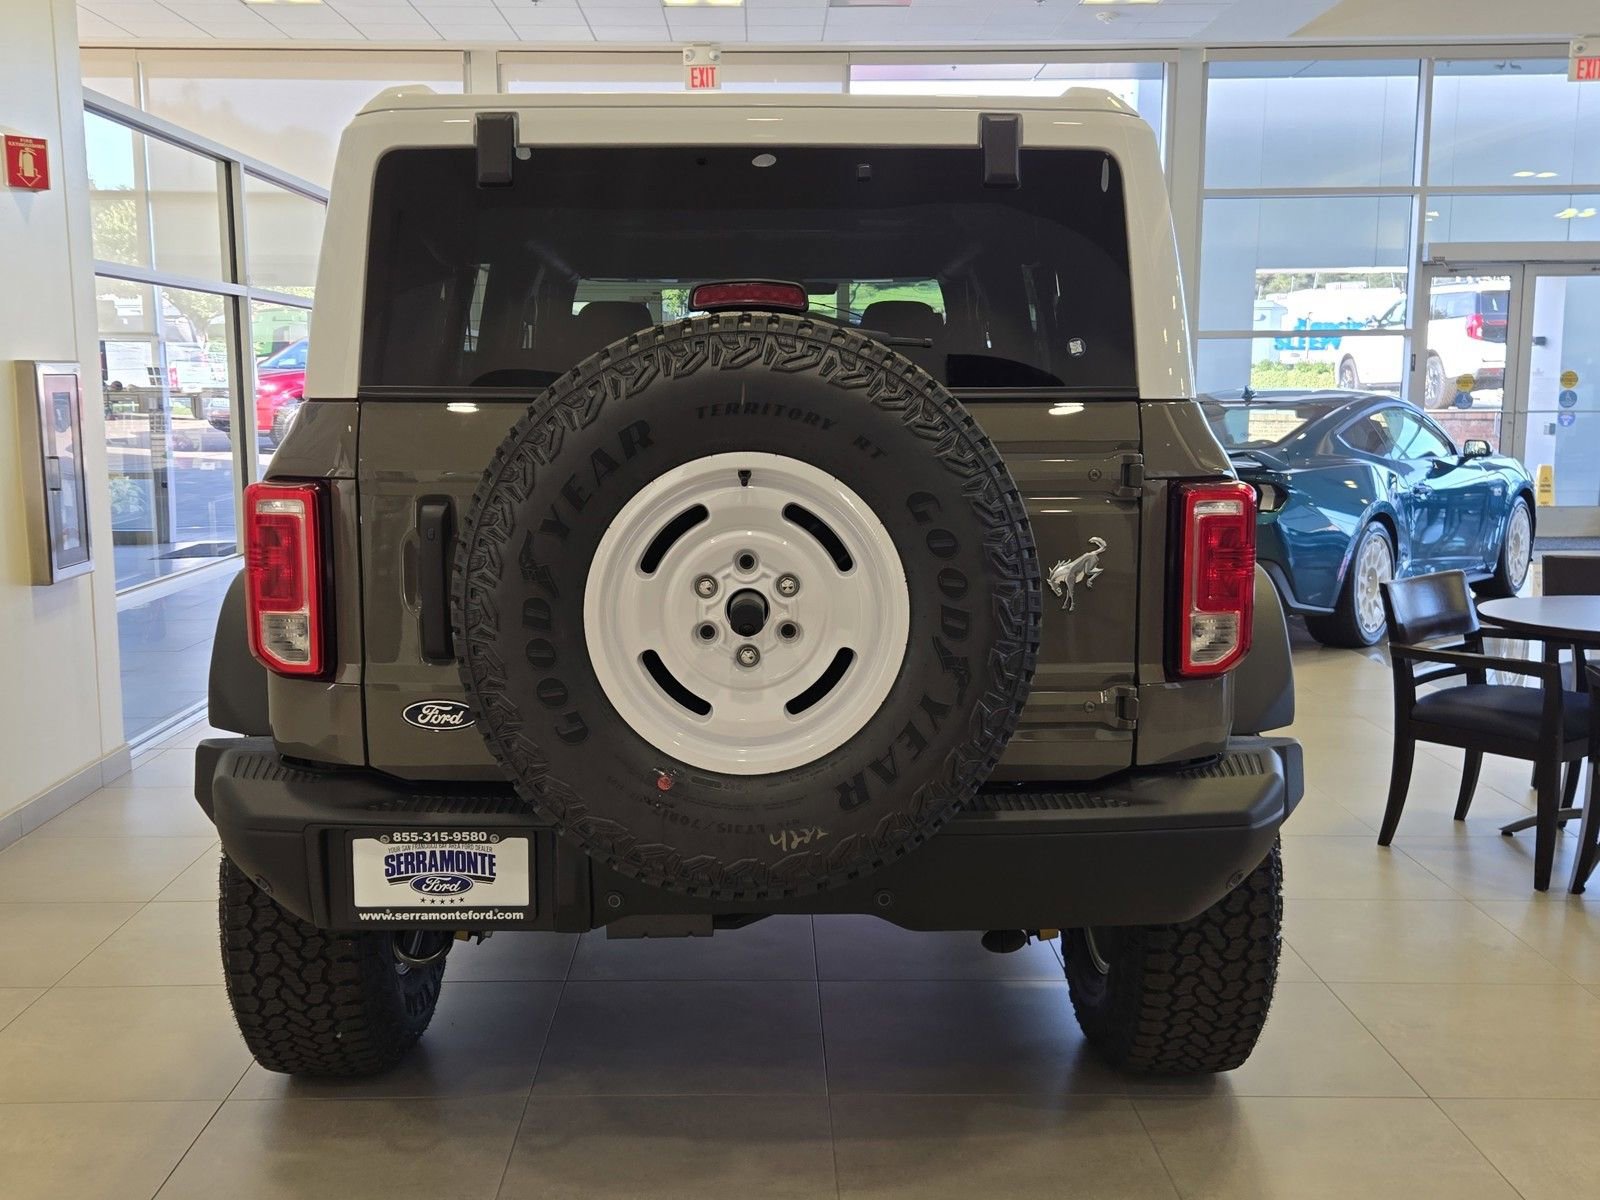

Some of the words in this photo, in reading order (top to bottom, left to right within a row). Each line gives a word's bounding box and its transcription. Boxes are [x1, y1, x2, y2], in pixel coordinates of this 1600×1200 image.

[690, 66, 716, 88] EXIT
[696, 402, 838, 430] TERRITORY
[853, 434, 888, 460] RT
[418, 704, 465, 725] Ford
[392, 831, 488, 843] 855-315-9580
[384, 850, 497, 878] SERRAMONTE
[421, 876, 461, 892] Ford
[358, 910, 524, 921] www.serramonteford.com
